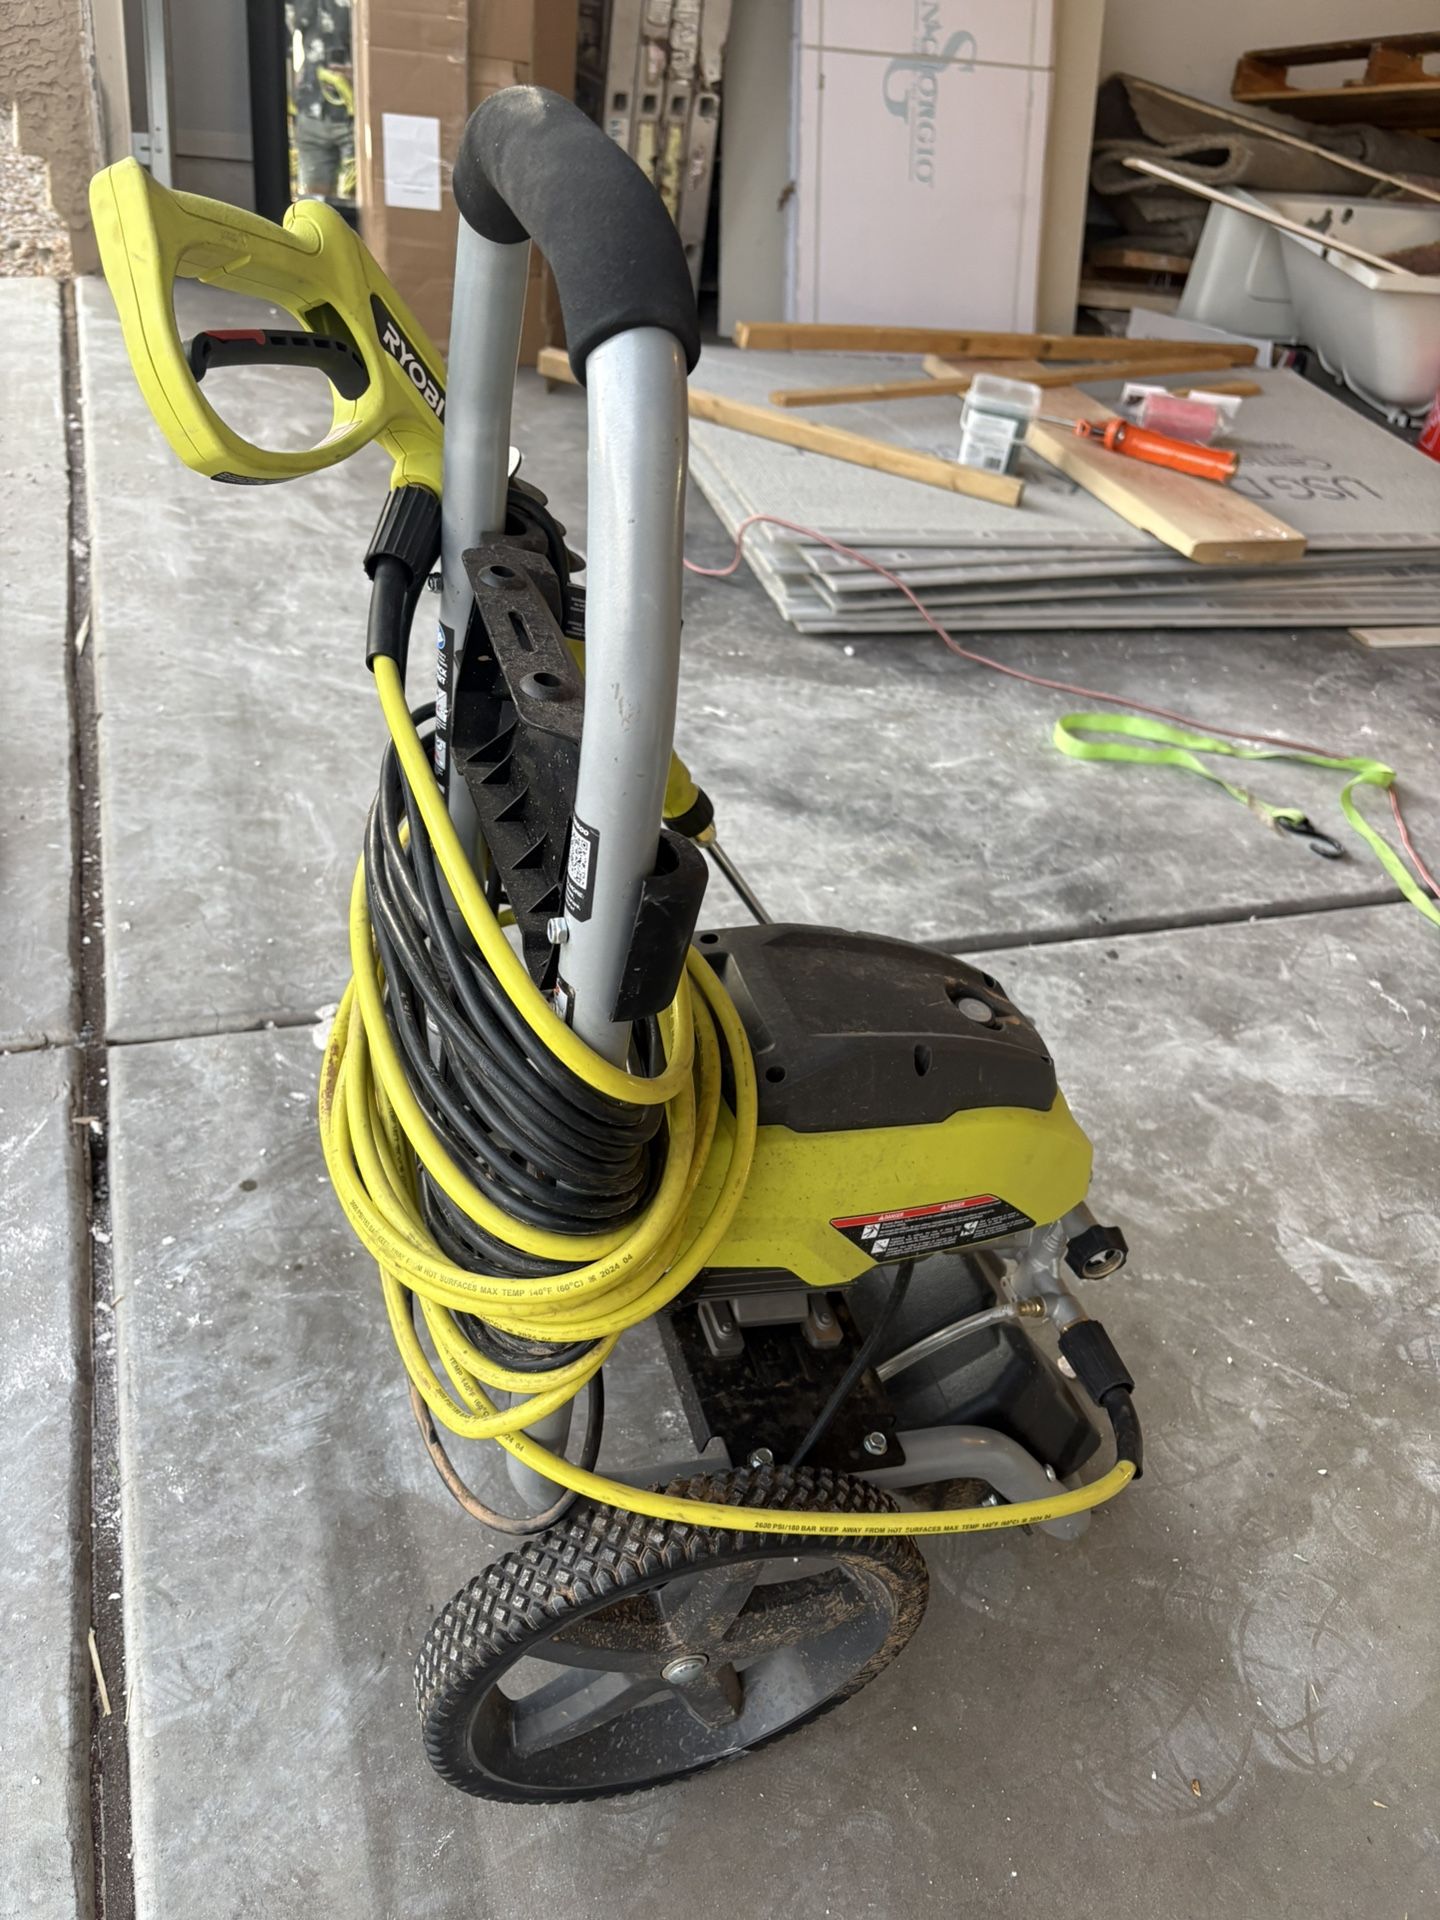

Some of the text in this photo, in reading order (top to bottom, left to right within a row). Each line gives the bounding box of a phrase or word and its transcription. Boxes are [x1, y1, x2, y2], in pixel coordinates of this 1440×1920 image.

[383, 321, 445, 417] RYOBI
[1267, 475, 1383, 500] USG
[440, 1274, 478, 1293] SURFACES
[480, 1286, 498, 1296] MAX
[502, 1288, 525, 1297] TEMP
[599, 1263, 621, 1279] 2024
[622, 1253, 633, 1264] 04
[450, 1356, 463, 1376] TEMP
[905, 1525, 941, 1533] SURFACES
